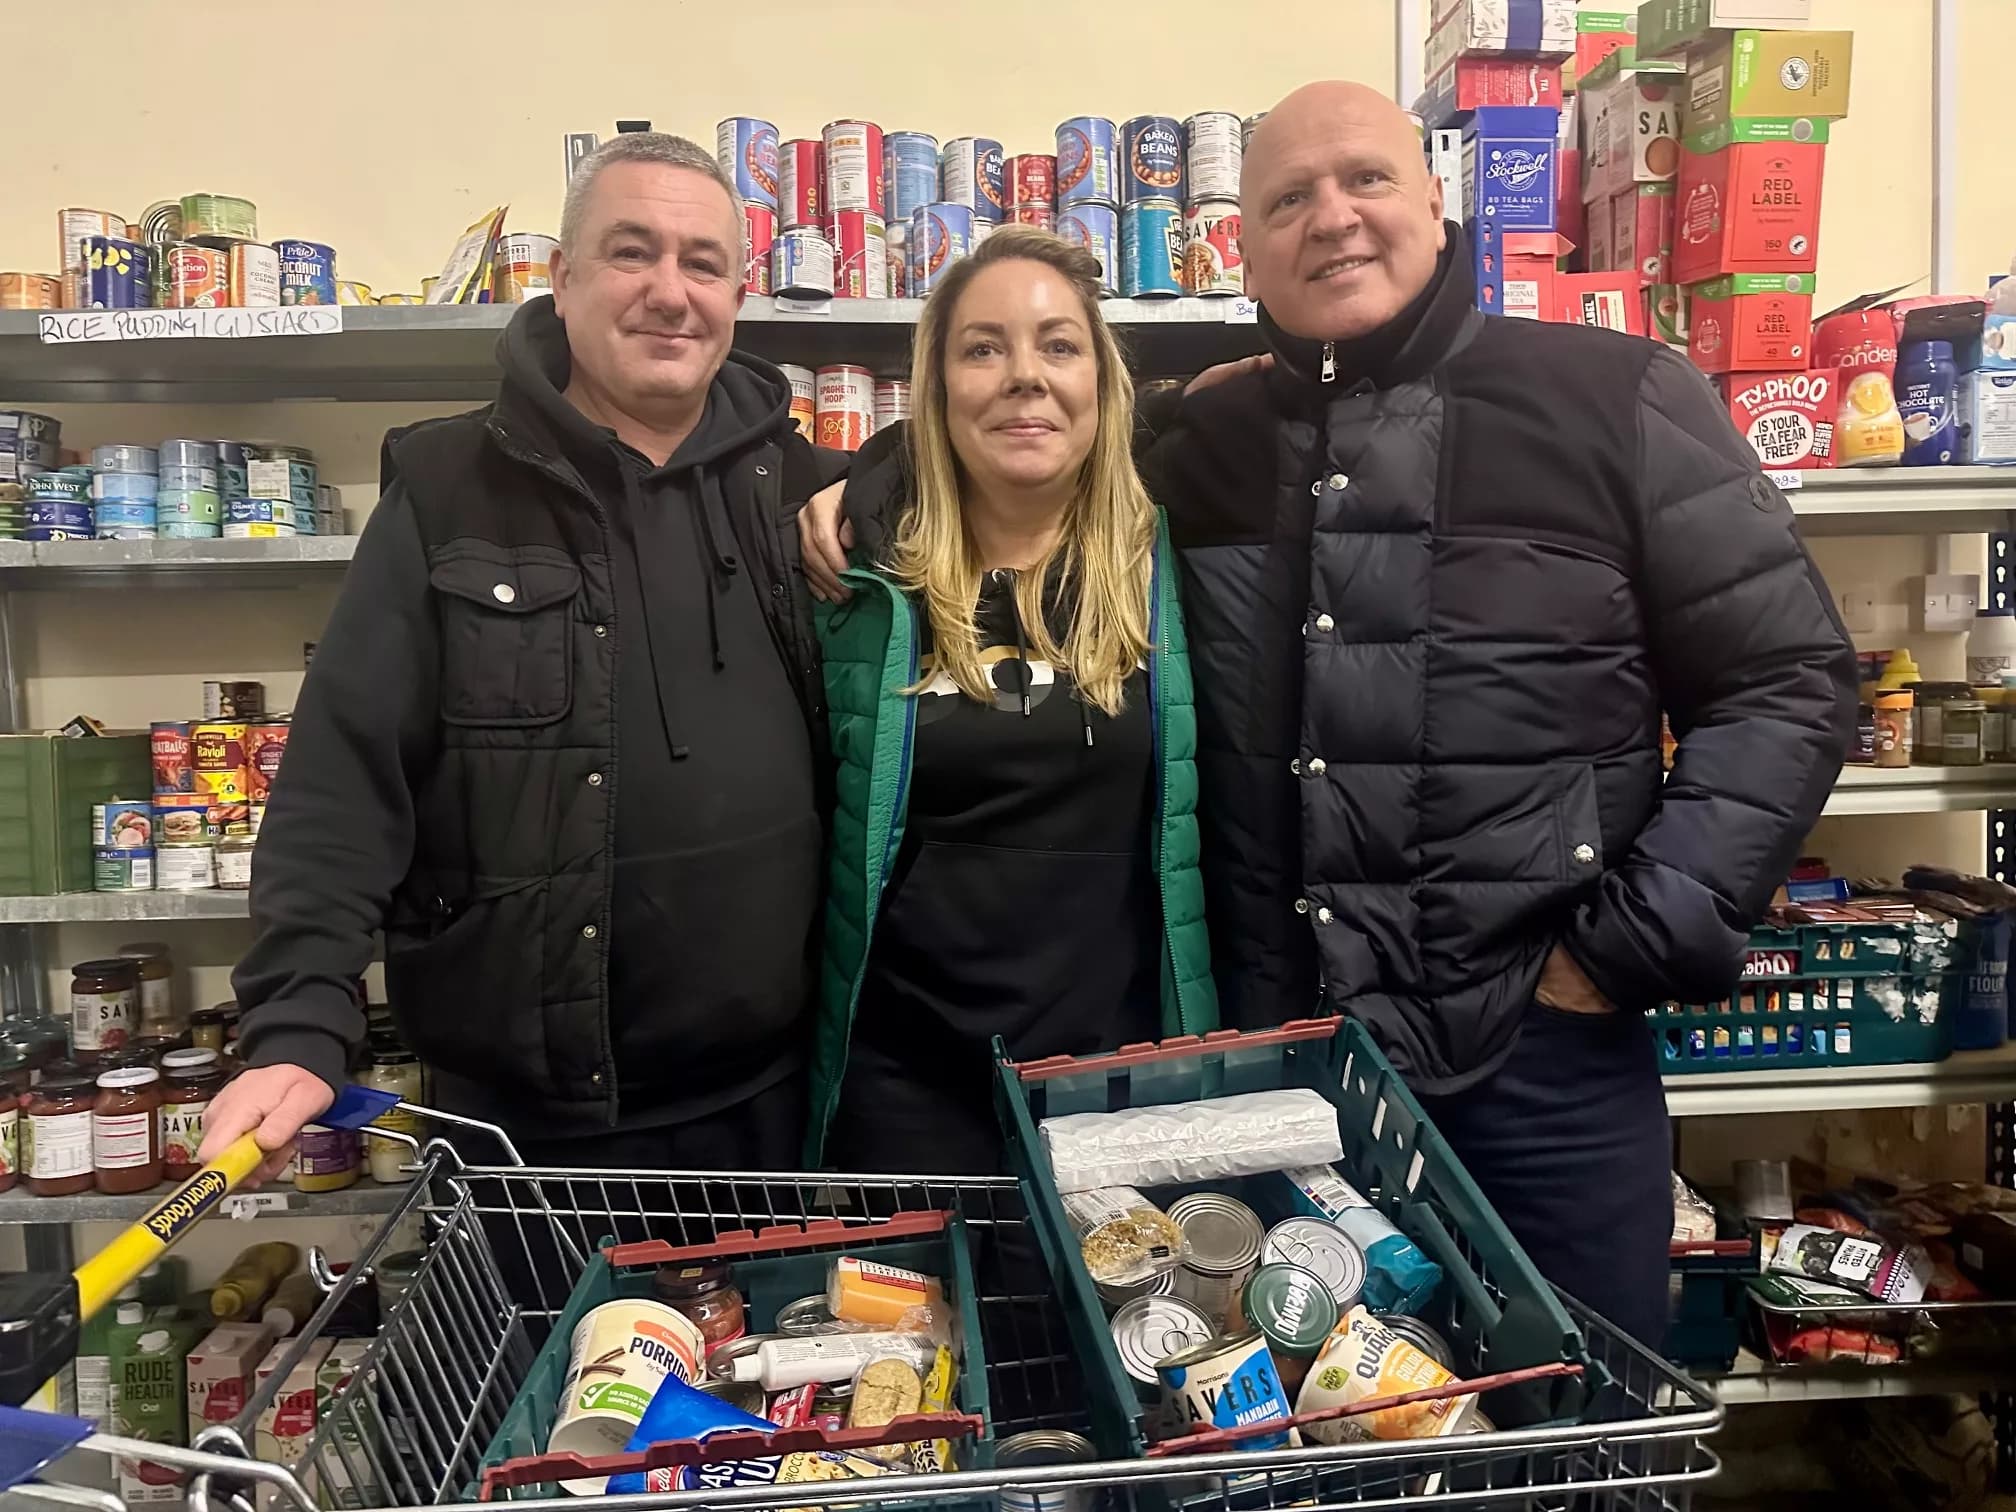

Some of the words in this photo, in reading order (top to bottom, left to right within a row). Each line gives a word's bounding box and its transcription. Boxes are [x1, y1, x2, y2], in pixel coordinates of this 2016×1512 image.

[1144, 130, 1175, 143] BAKED
[1141, 143, 1178, 157] BEANS
[1486, 153, 1548, 179] Stockwell
[1763, 179, 1793, 191] RED
[1502, 196, 1518, 204] TEA
[1521, 196, 1544, 204] BAGS
[1752, 192, 1802, 205] LABEL
[1185, 220, 1240, 241] SAVERS
[286, 273, 313, 286] MILK
[1764, 314, 1785, 323] RED
[41, 316, 106, 342] RICE
[1756, 324, 1791, 333] LABEL
[1910, 390, 1929, 399] HOT
[1758, 420, 1769, 434] IS
[1770, 414, 1800, 431] YOUR
[1754, 433, 1777, 448] TEA
[1777, 427, 1807, 444] FEAR
[1765, 442, 1800, 460] FREE?
[30, 479, 51, 490] JOHN
[54, 482, 81, 492] WEST
[197, 745, 226, 758] Ravioli
[184, 1172, 225, 1206] Heron
[150, 1197, 194, 1238] Foods
[125, 1361, 174, 1384] RUDE
[1197, 1372, 1229, 1386] Morrisons
[125, 1384, 175, 1400] HEALTH
[1173, 1367, 1273, 1424] SAVERS
[140, 1403, 160, 1413] Oat
[1235, 1398, 1280, 1426] MANDARIN
